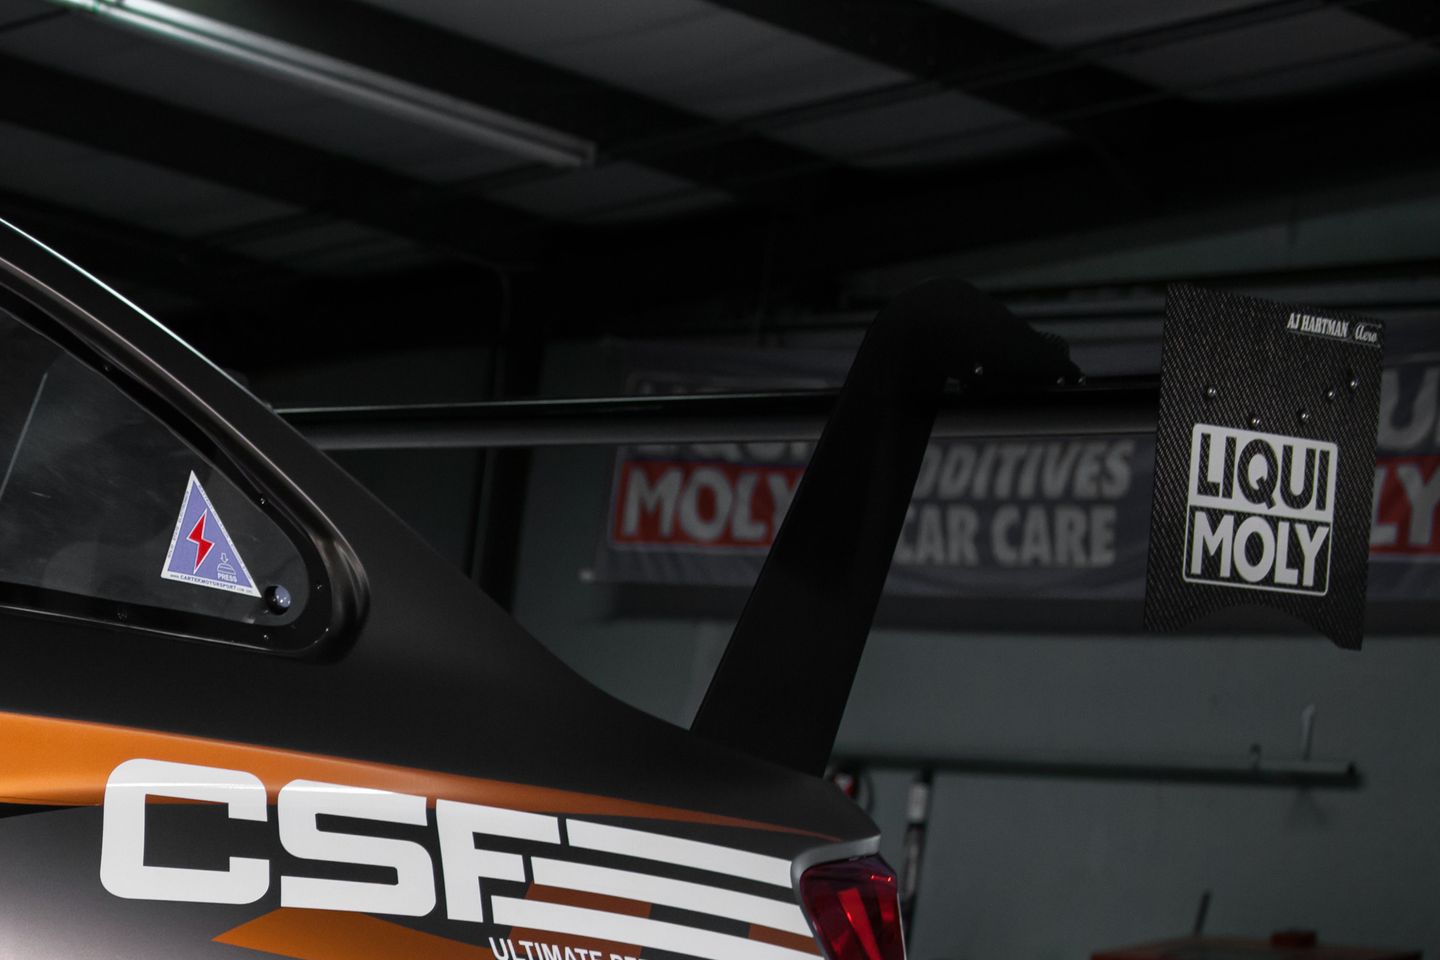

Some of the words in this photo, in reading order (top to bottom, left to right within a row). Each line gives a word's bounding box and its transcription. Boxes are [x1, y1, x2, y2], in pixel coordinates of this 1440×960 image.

[1287, 312, 1301, 330] AJ
[1301, 314, 1350, 338] HARTMAN
[913, 440, 1135, 499] DDITIVES
[1197, 432, 1330, 510] LIQUI
[992, 504, 1116, 568] CARE
[1190, 511, 1330, 587] MOLY
[217, 573, 238, 584] PRESS
[100, 758, 561, 923] CSF
